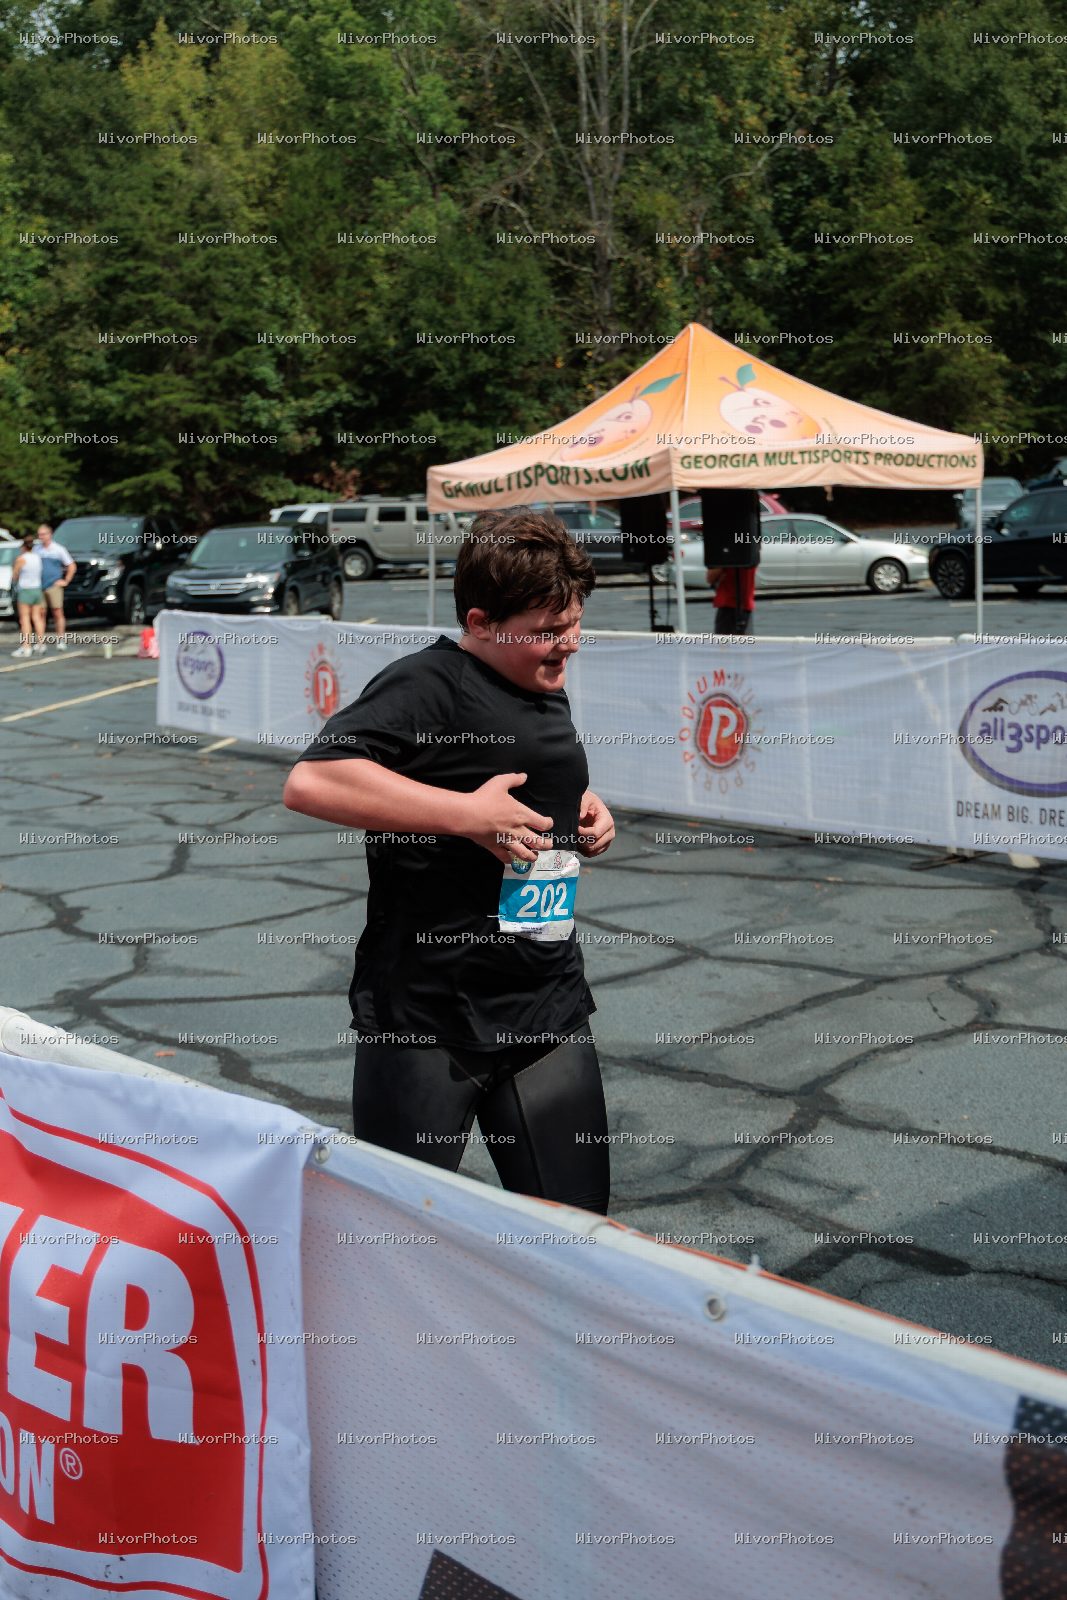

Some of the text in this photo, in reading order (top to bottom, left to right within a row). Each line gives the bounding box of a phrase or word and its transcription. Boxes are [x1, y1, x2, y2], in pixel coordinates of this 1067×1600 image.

[680, 449, 977, 470] GEORGIA MULTISPORTS PRODUCTIONS
[679, 668, 726, 765] PODIUM
[956, 801, 1001, 820] DREAM
[1007, 805, 1033, 824] BIG.
[516, 881, 569, 919] 202
[0, 1201, 195, 1444] ER
